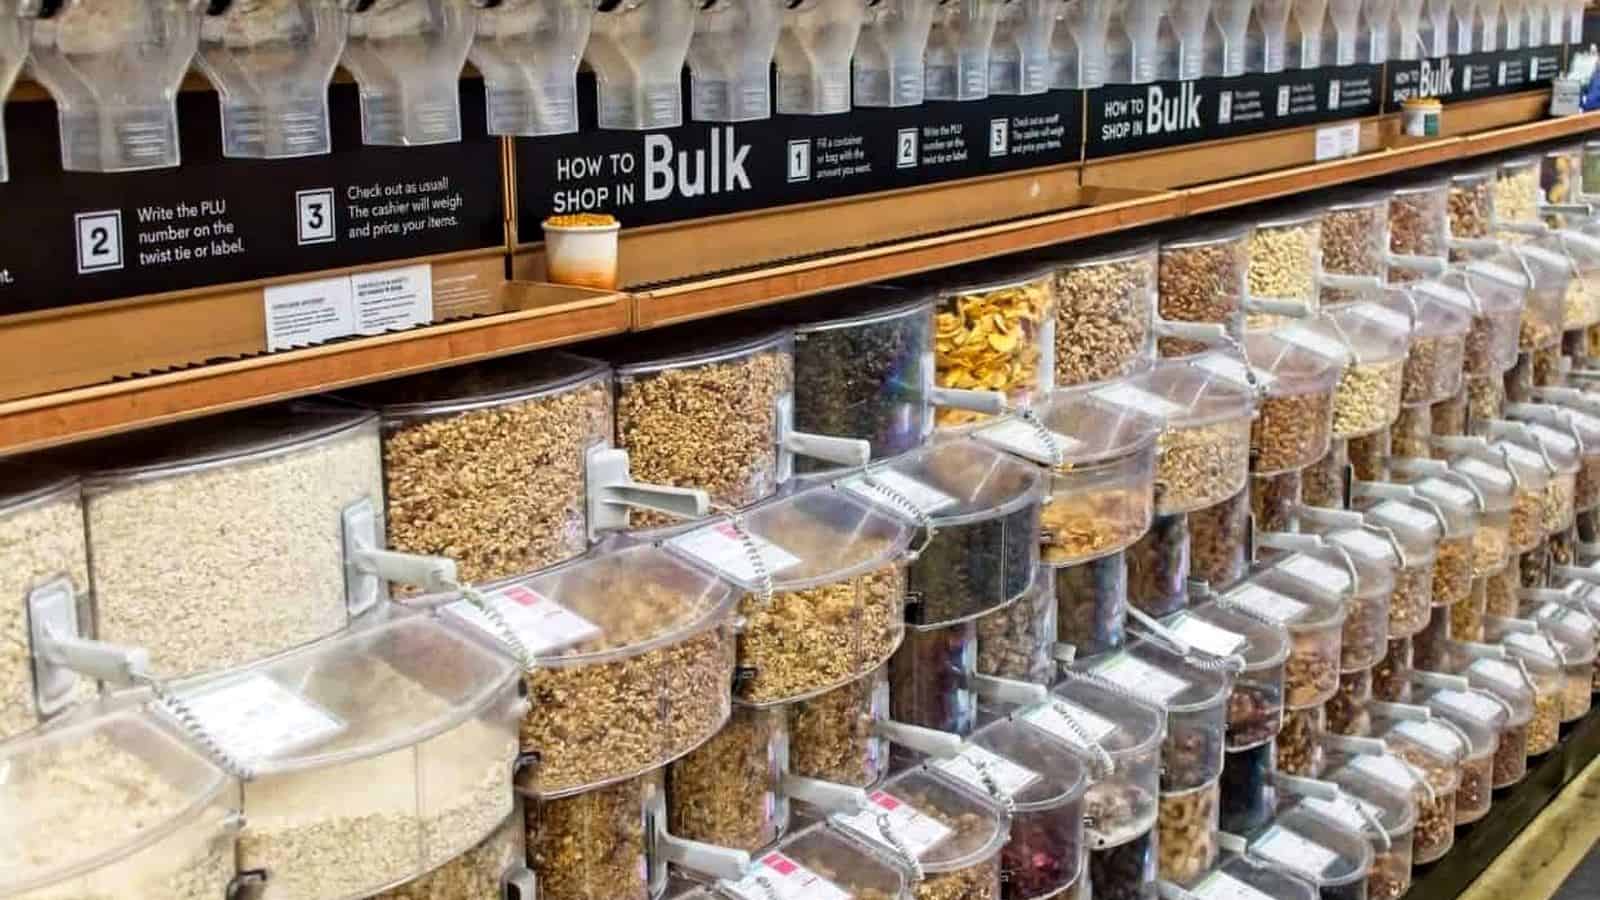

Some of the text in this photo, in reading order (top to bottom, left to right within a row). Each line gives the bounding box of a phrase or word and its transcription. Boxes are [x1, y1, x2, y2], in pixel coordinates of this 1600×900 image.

[1420, 58, 1454, 97] Bulk
[1104, 98, 1144, 118] HOW TO
[1146, 81, 1202, 134] Bulk
[995, 129, 1003, 147] 3
[1102, 120, 1143, 141] SHOP IN
[794, 151, 802, 172] 1
[903, 139, 911, 158] 2
[556, 152, 635, 182] HOW TO
[644, 126, 752, 202] Bulk
[348, 183, 382, 200] Check
[384, 182, 403, 196] out
[404, 182, 417, 193] as
[553, 183, 634, 214] SHOP IN
[136, 199, 226, 223] Write the PLU
[307, 202, 323, 230] 3
[348, 193, 463, 219] The cashier will weigh
[90, 227, 110, 257] 2
[138, 218, 234, 244] number on the
[349, 223, 370, 239] and
[373, 223, 400, 239] price
[402, 220, 426, 235] your
[139, 237, 246, 265] twist tie or label.
